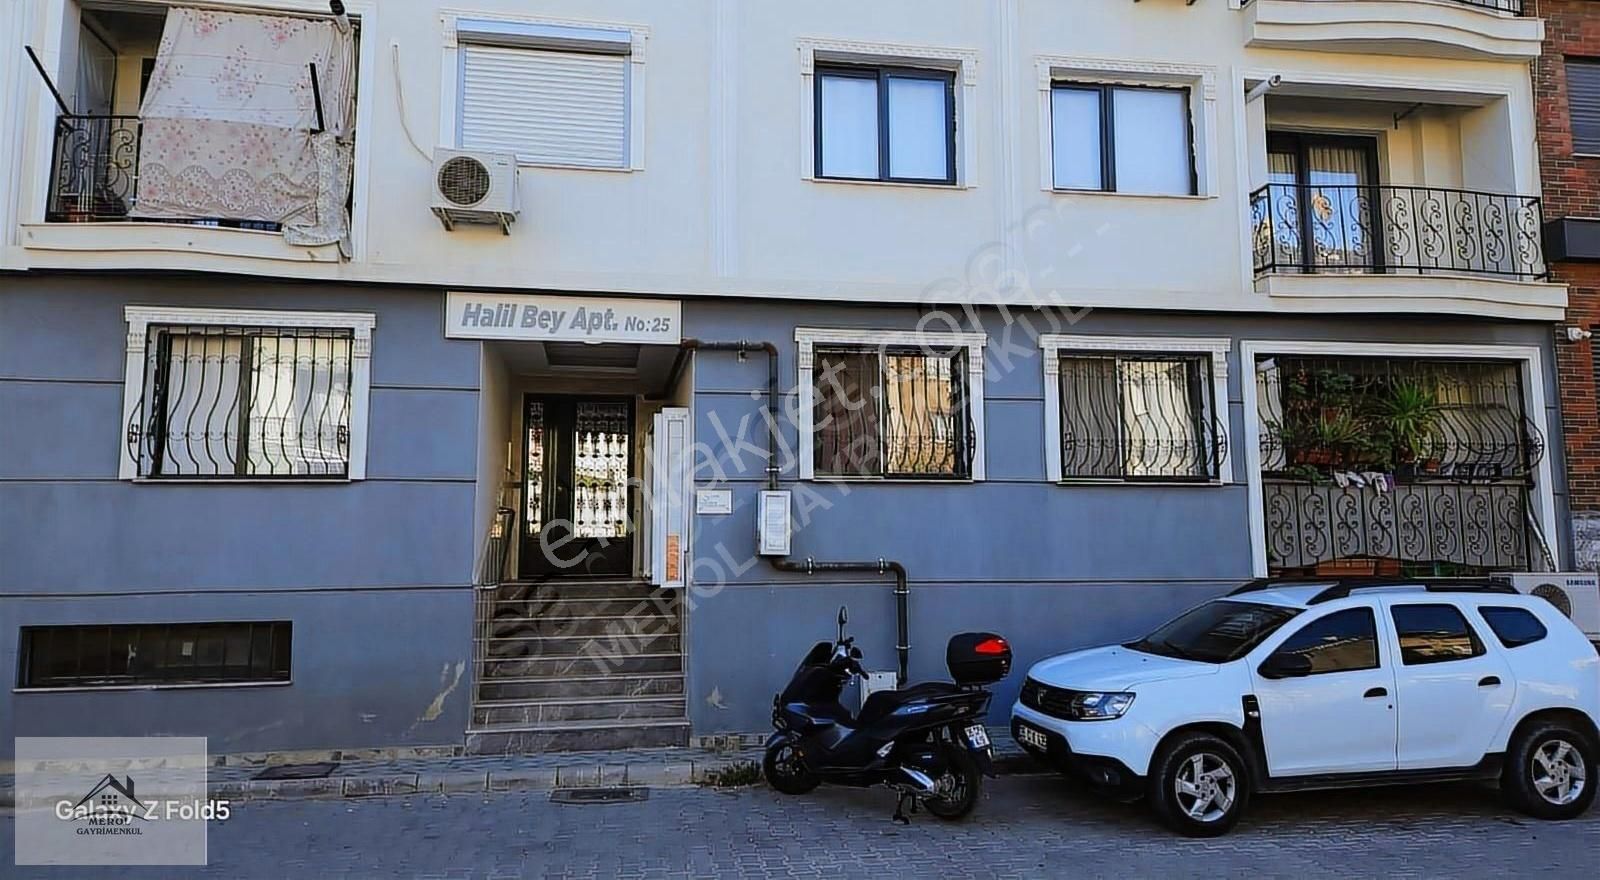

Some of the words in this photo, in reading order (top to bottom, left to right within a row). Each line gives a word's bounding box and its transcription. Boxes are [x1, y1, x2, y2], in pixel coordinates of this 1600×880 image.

[461, 303, 518, 328] Halil
[520, 305, 566, 334] Bey
[569, 307, 619, 335] Apt.
[624, 315, 671, 333] No:25
